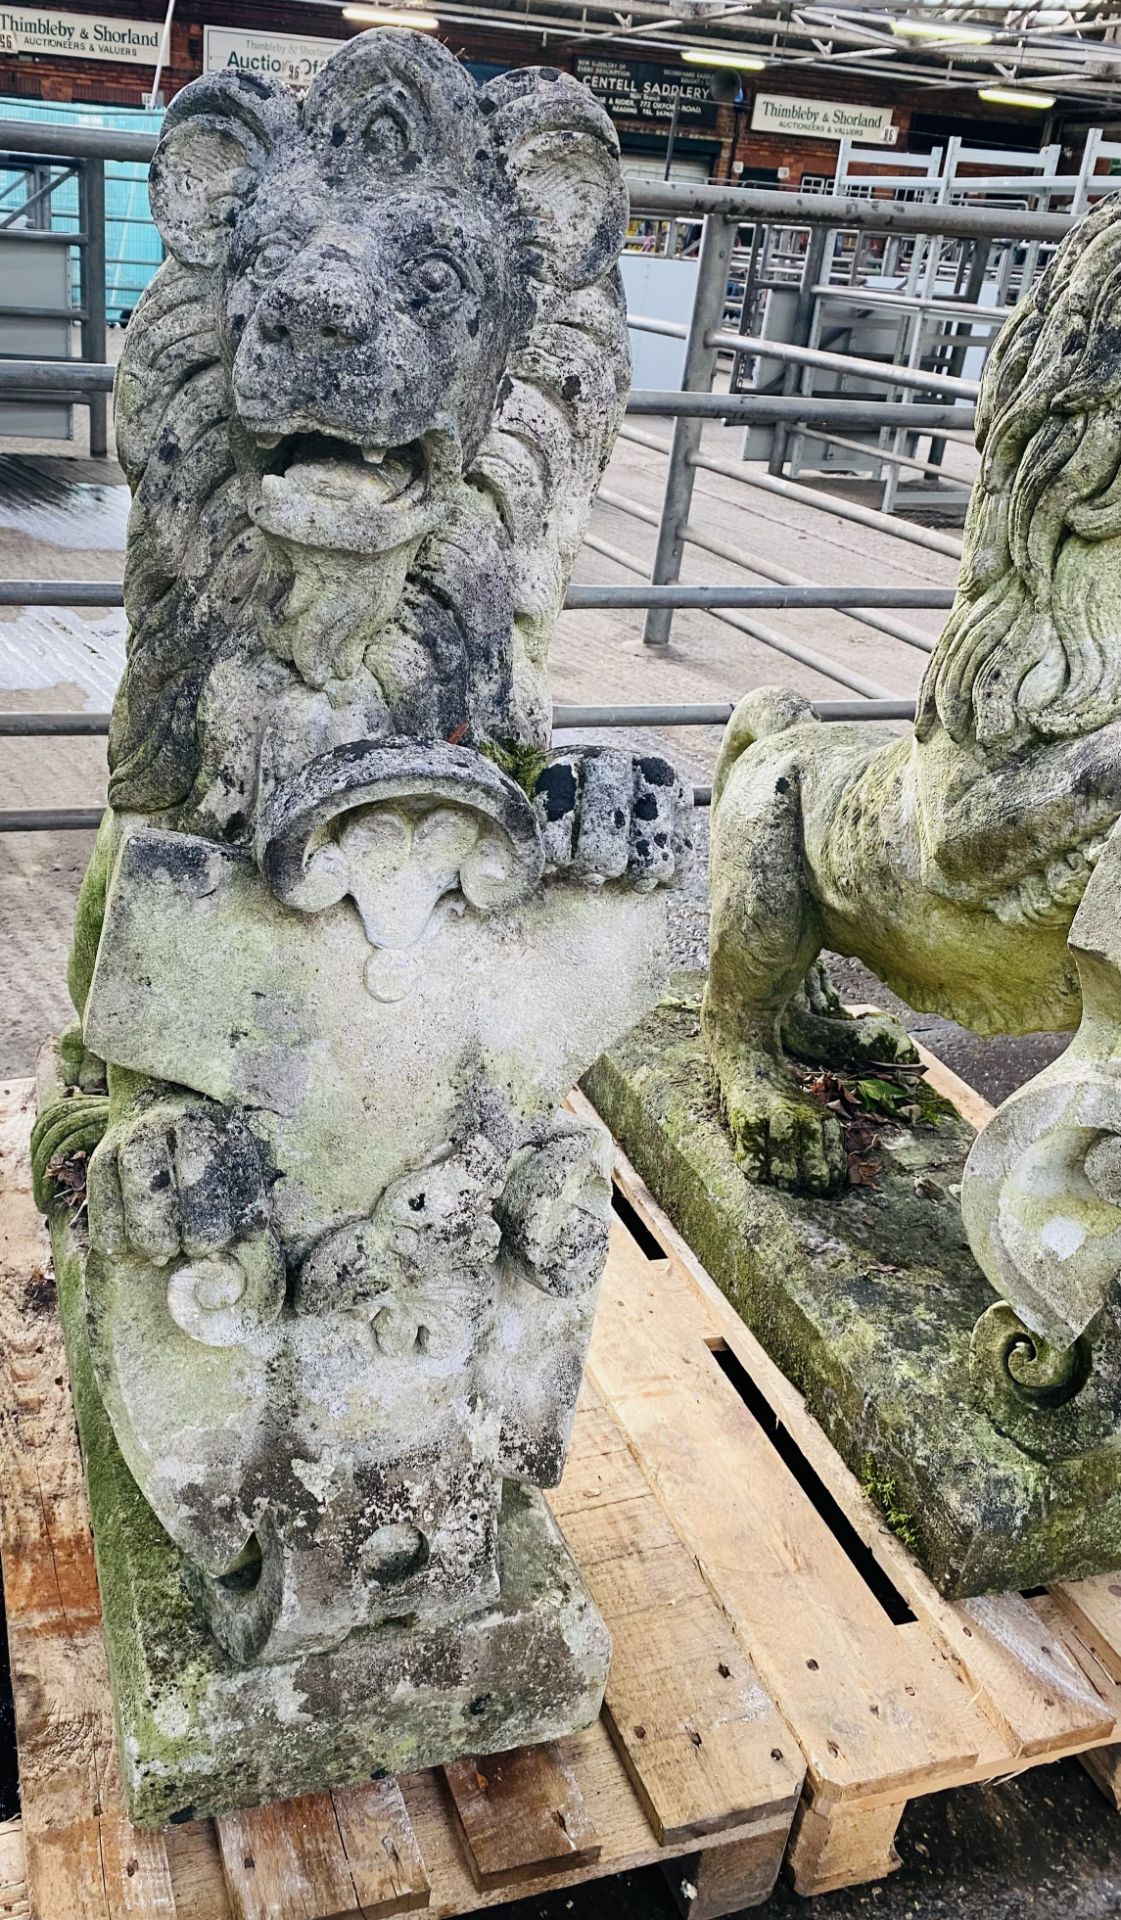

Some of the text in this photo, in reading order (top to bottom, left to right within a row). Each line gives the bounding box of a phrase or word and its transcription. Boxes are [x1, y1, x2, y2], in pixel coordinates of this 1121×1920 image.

[0, 13, 159, 47] Thimbleby & Shorland
[24, 36, 137, 56] AUCTIONEERS & VALUERS
[583, 75, 637, 92] CENTELL
[643, 82, 711, 99] SADDLERY
[762, 101, 882, 129] Thimbleby & Shorland
[778, 121, 863, 136] AUCTIONEERS & VALUERS
